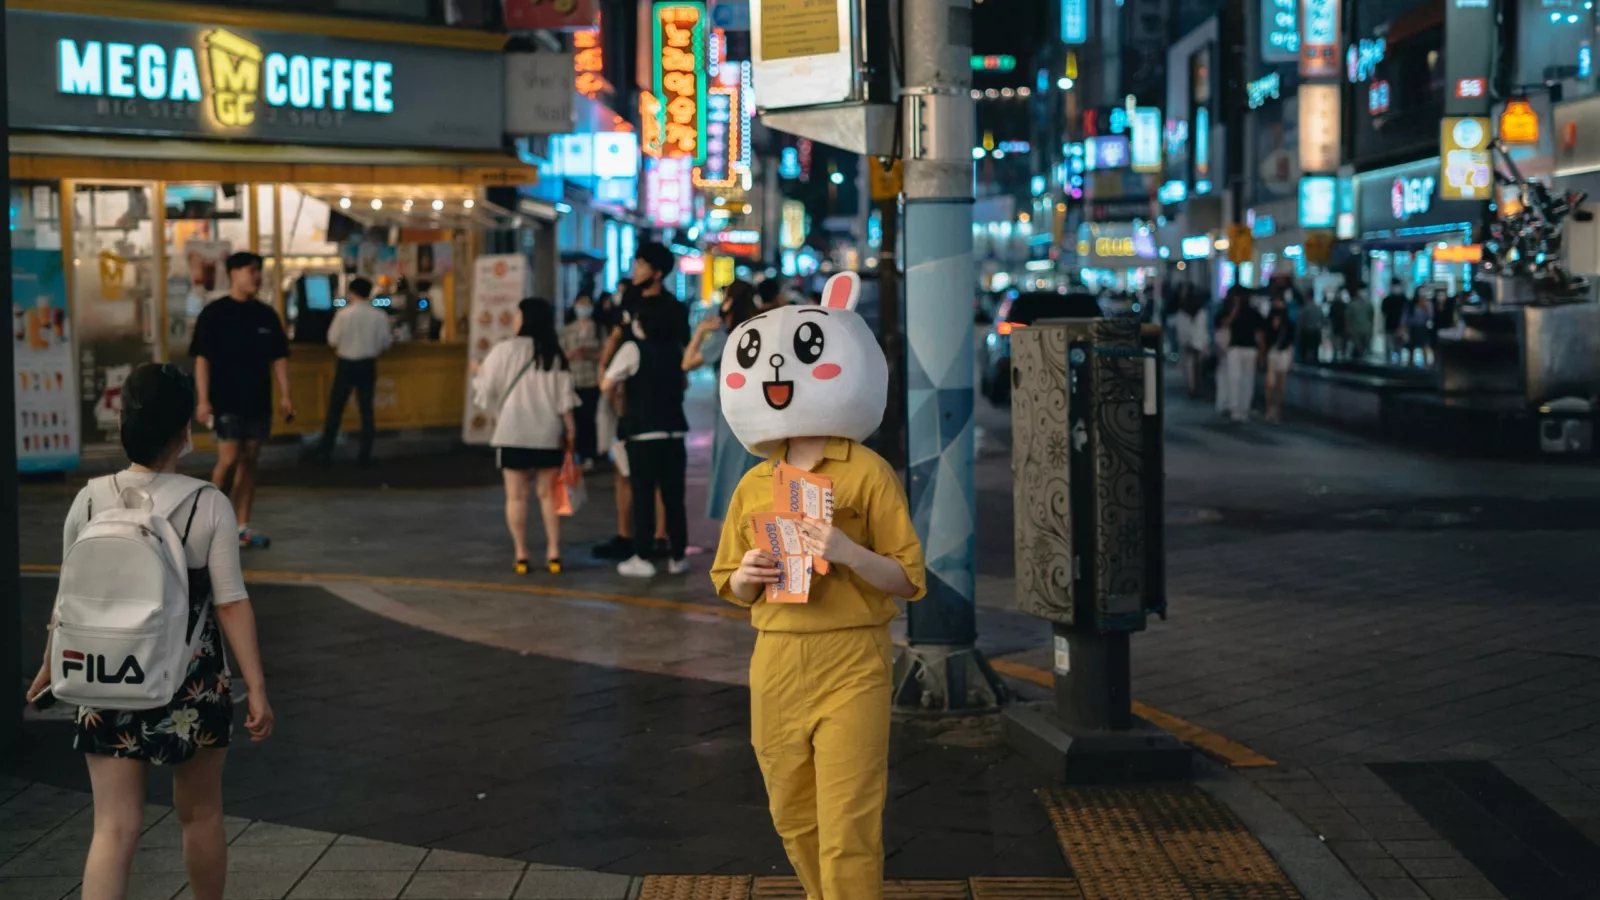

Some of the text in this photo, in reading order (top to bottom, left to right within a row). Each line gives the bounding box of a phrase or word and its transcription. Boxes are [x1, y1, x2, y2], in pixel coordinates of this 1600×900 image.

[57, 38, 394, 114] MEGA COFFEE
[97, 98, 138, 118] BIG
[214, 92, 256, 127] GC
[62, 649, 145, 685] FILA
